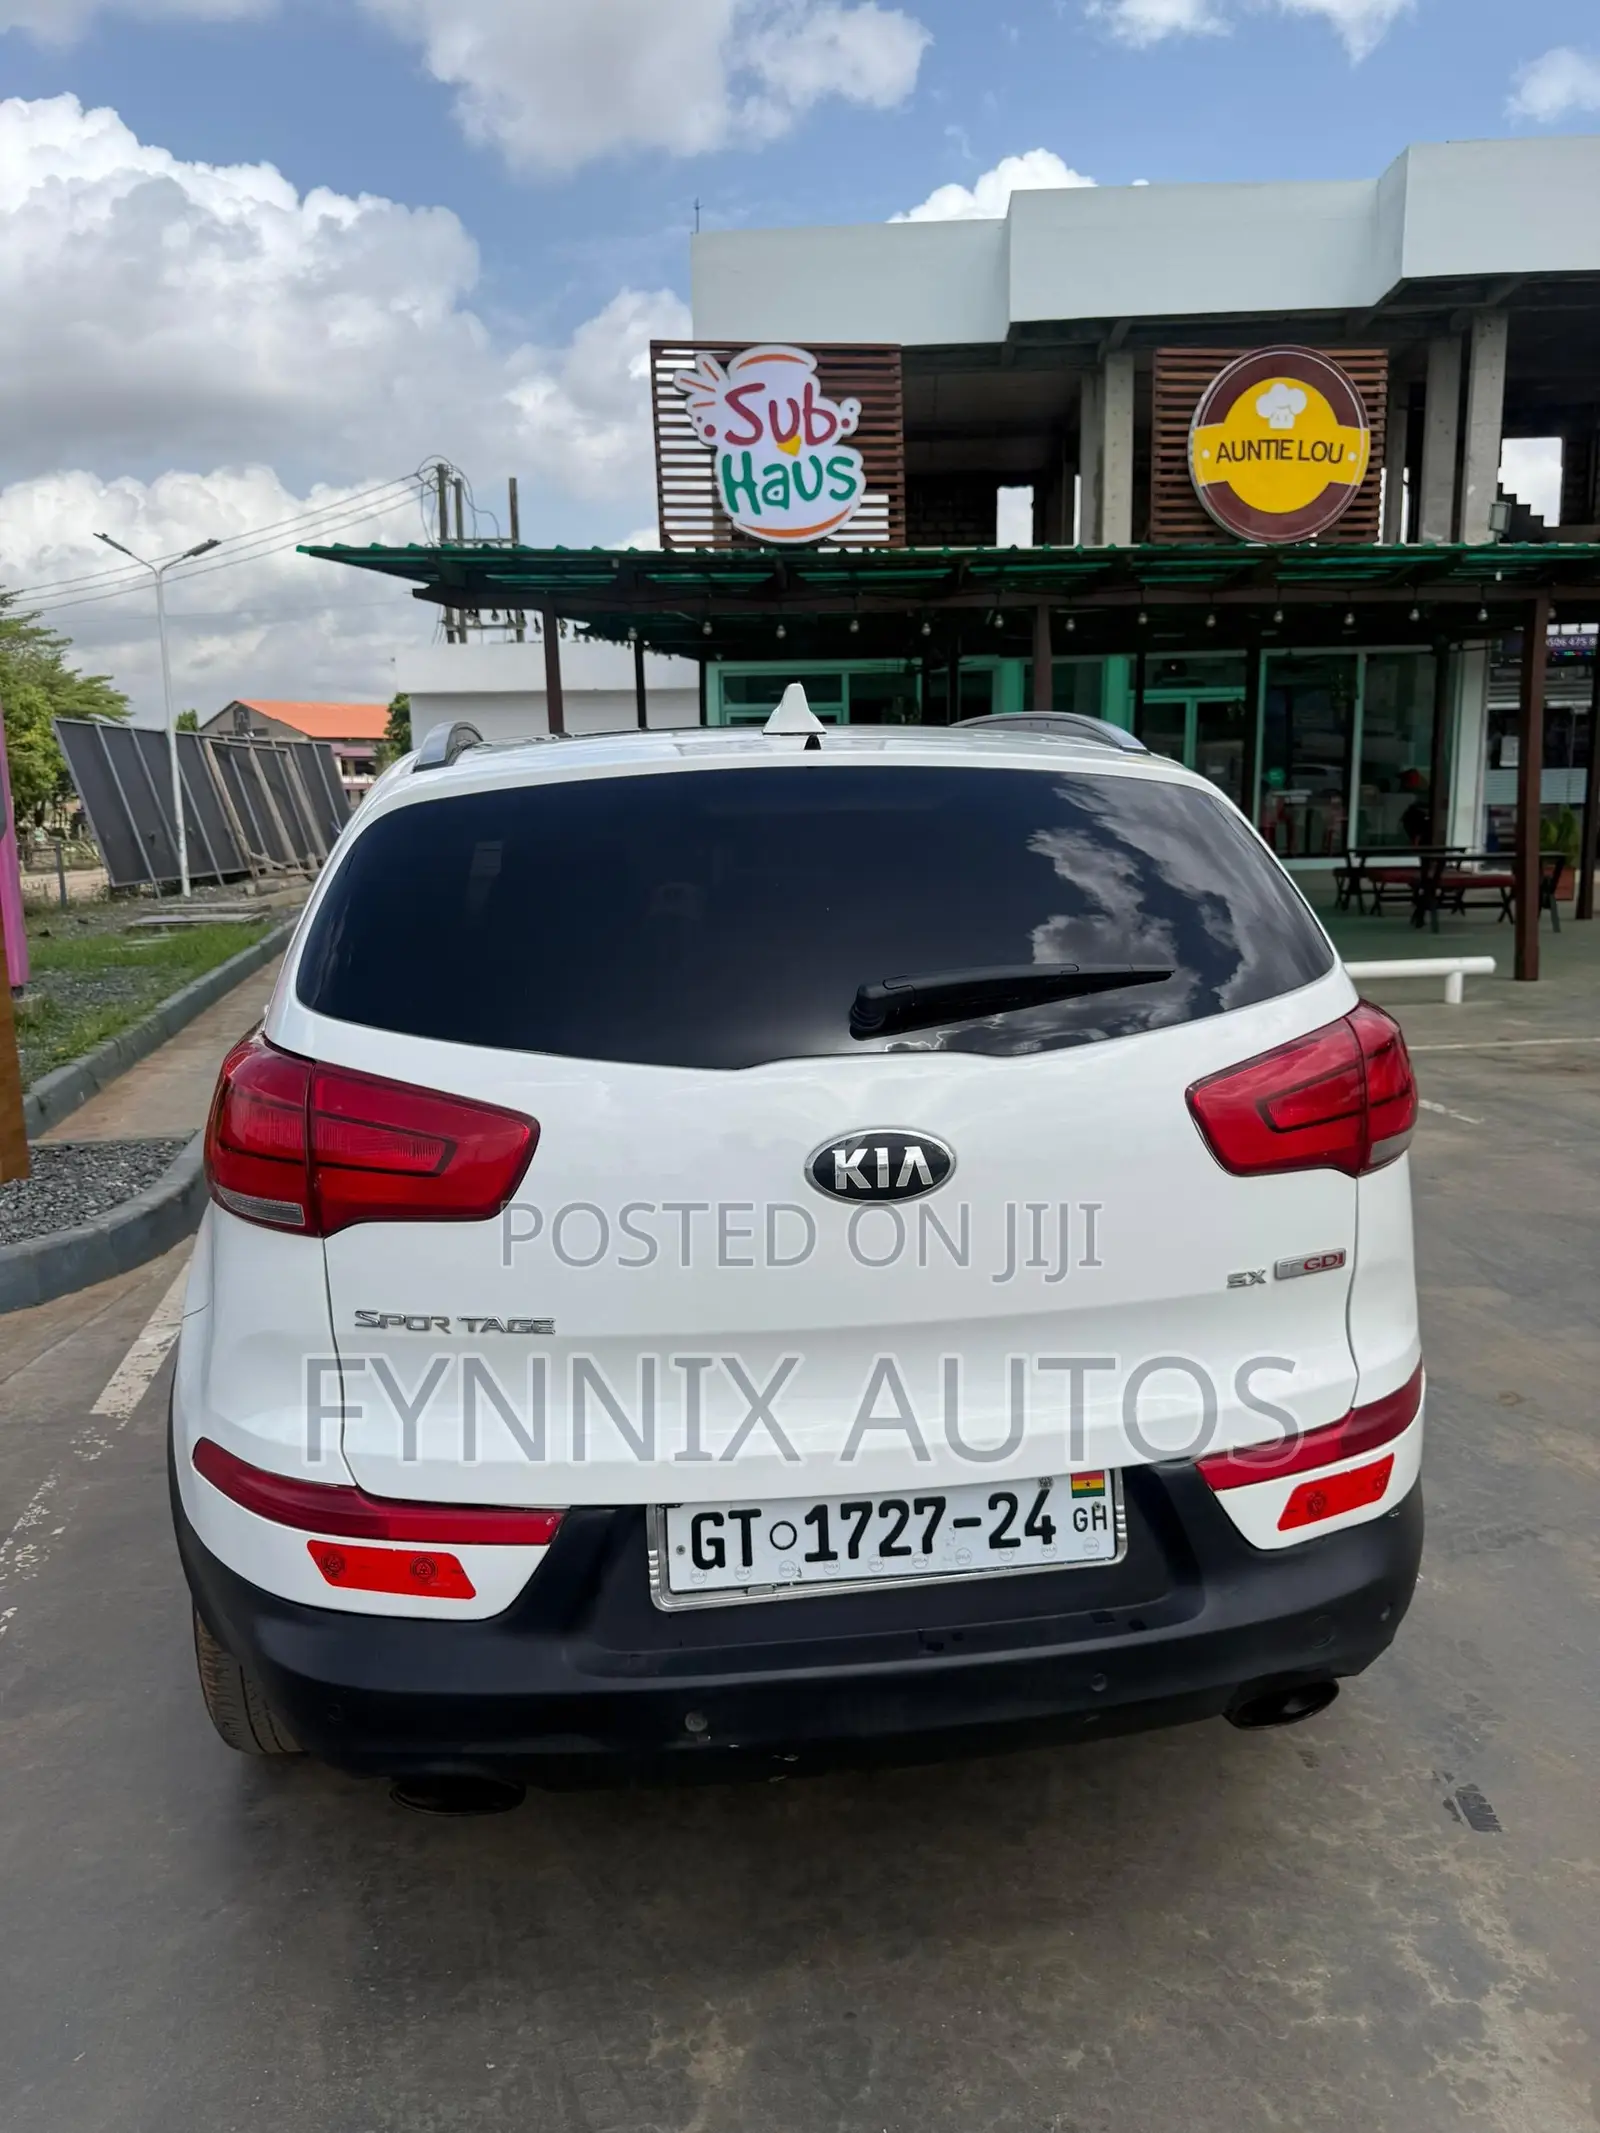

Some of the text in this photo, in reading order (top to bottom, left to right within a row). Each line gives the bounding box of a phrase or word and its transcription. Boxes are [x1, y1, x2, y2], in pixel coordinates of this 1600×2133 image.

[724, 382, 837, 446] Sub
[1216, 439, 1345, 464] AUNTIE LOU
[721, 451, 858, 515] Haus
[833, 1146, 933, 1189] KIA
[691, 1489, 1057, 1571] GT 1727-24
[1073, 1505, 1108, 1533] GH
